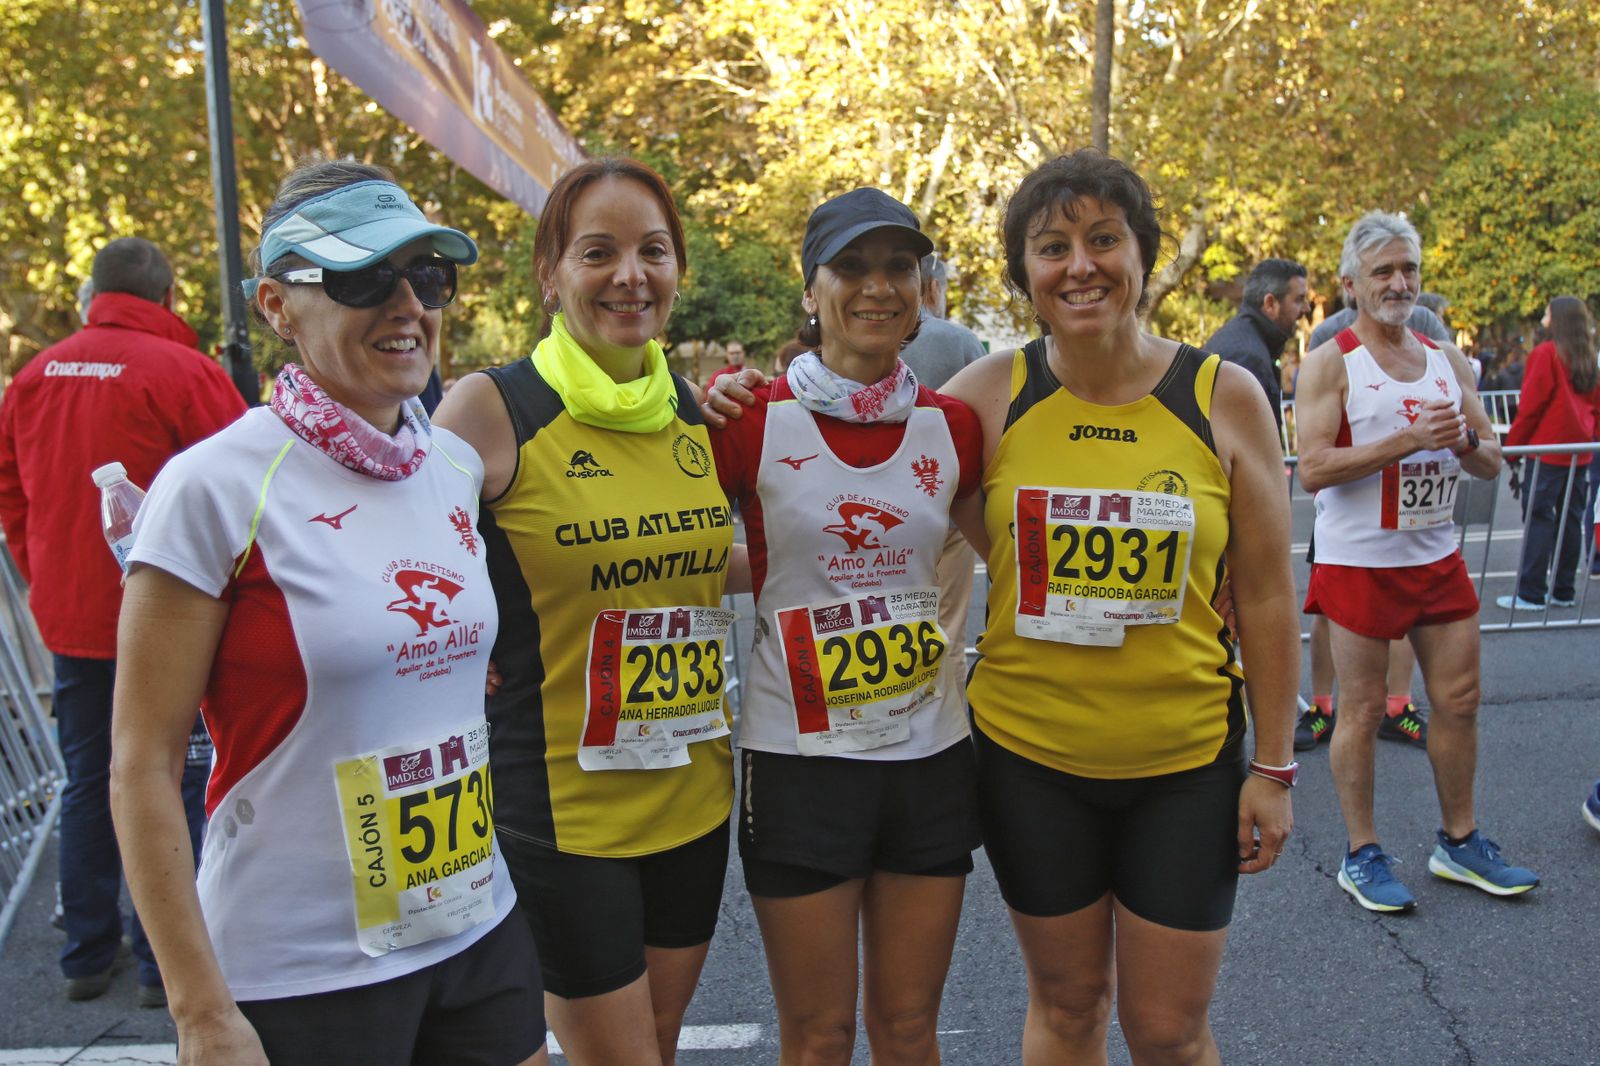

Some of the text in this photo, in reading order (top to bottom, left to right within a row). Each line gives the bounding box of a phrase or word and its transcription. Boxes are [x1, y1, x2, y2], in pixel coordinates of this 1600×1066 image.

[44, 360, 122, 380] Cruzcampo
[1138, 498, 1151, 506] 35
[1402, 475, 1457, 508] 3217
[826, 493, 910, 518] CLUB DE ATLETISMO
[1051, 507, 1090, 518] IMDECO
[555, 517, 630, 546] CLUB
[1025, 517, 1042, 585] CAJÓN 4
[1052, 525, 1179, 584] 2931
[382, 559, 465, 584] CLUB DE ATLETISMO
[591, 546, 729, 591] MONTILLA
[829, 574, 854, 583] Aguilar
[867, 570, 874, 578] la
[876, 568, 907, 576] Frontera
[890, 592, 937, 603] 35 MEDIA
[1048, 582, 1177, 600] RAFI CORDOBA GARCIA
[693, 610, 735, 619] 35 MEDIA
[816, 617, 853, 632] IMDECO
[1104, 611, 1144, 621] Cruzcampo
[627, 627, 662, 637] IMDECO
[607, 639, 616, 648] 4
[395, 650, 477, 677] Aguilar de la Frontera
[822, 621, 945, 692] 2936
[626, 640, 723, 703] 2933
[794, 634, 816, 704] CAJÓN 4
[825, 690, 872, 706] JOSEFINA
[619, 699, 720, 721] ANA HERRADOR LUQUE
[468, 730, 478, 741] 35
[672, 727, 702, 738] Cruzcampo
[388, 766, 434, 787] IMDECO
[357, 794, 386, 888] CAJÓN 5
[406, 866, 439, 889] ANA
[442, 847, 487, 877] GARCIA
